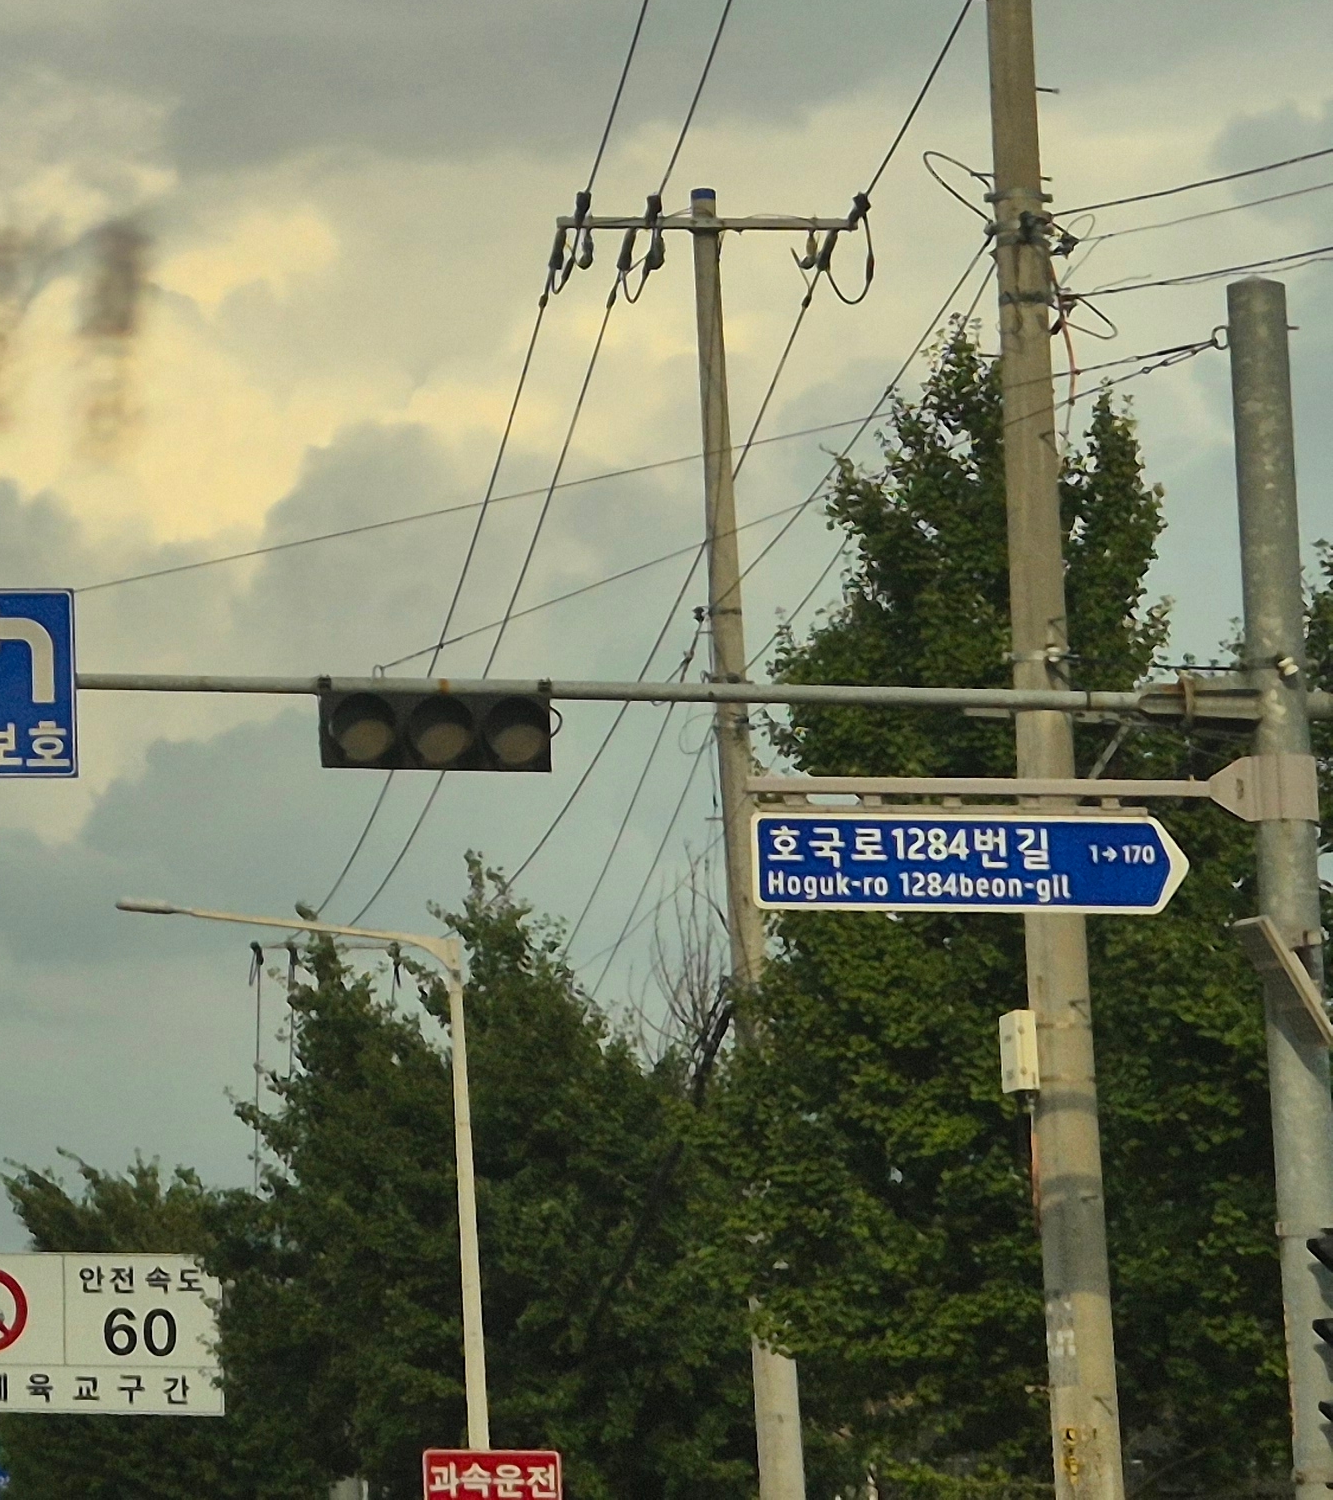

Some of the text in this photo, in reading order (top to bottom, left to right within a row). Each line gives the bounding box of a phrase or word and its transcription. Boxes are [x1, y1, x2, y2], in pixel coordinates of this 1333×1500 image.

[767, 871, 1071, 903] Hoguk-ro 1284beon-gil
[103, 1307, 178, 1357] 60
[429, 1461, 558, 1498] 과속운전
